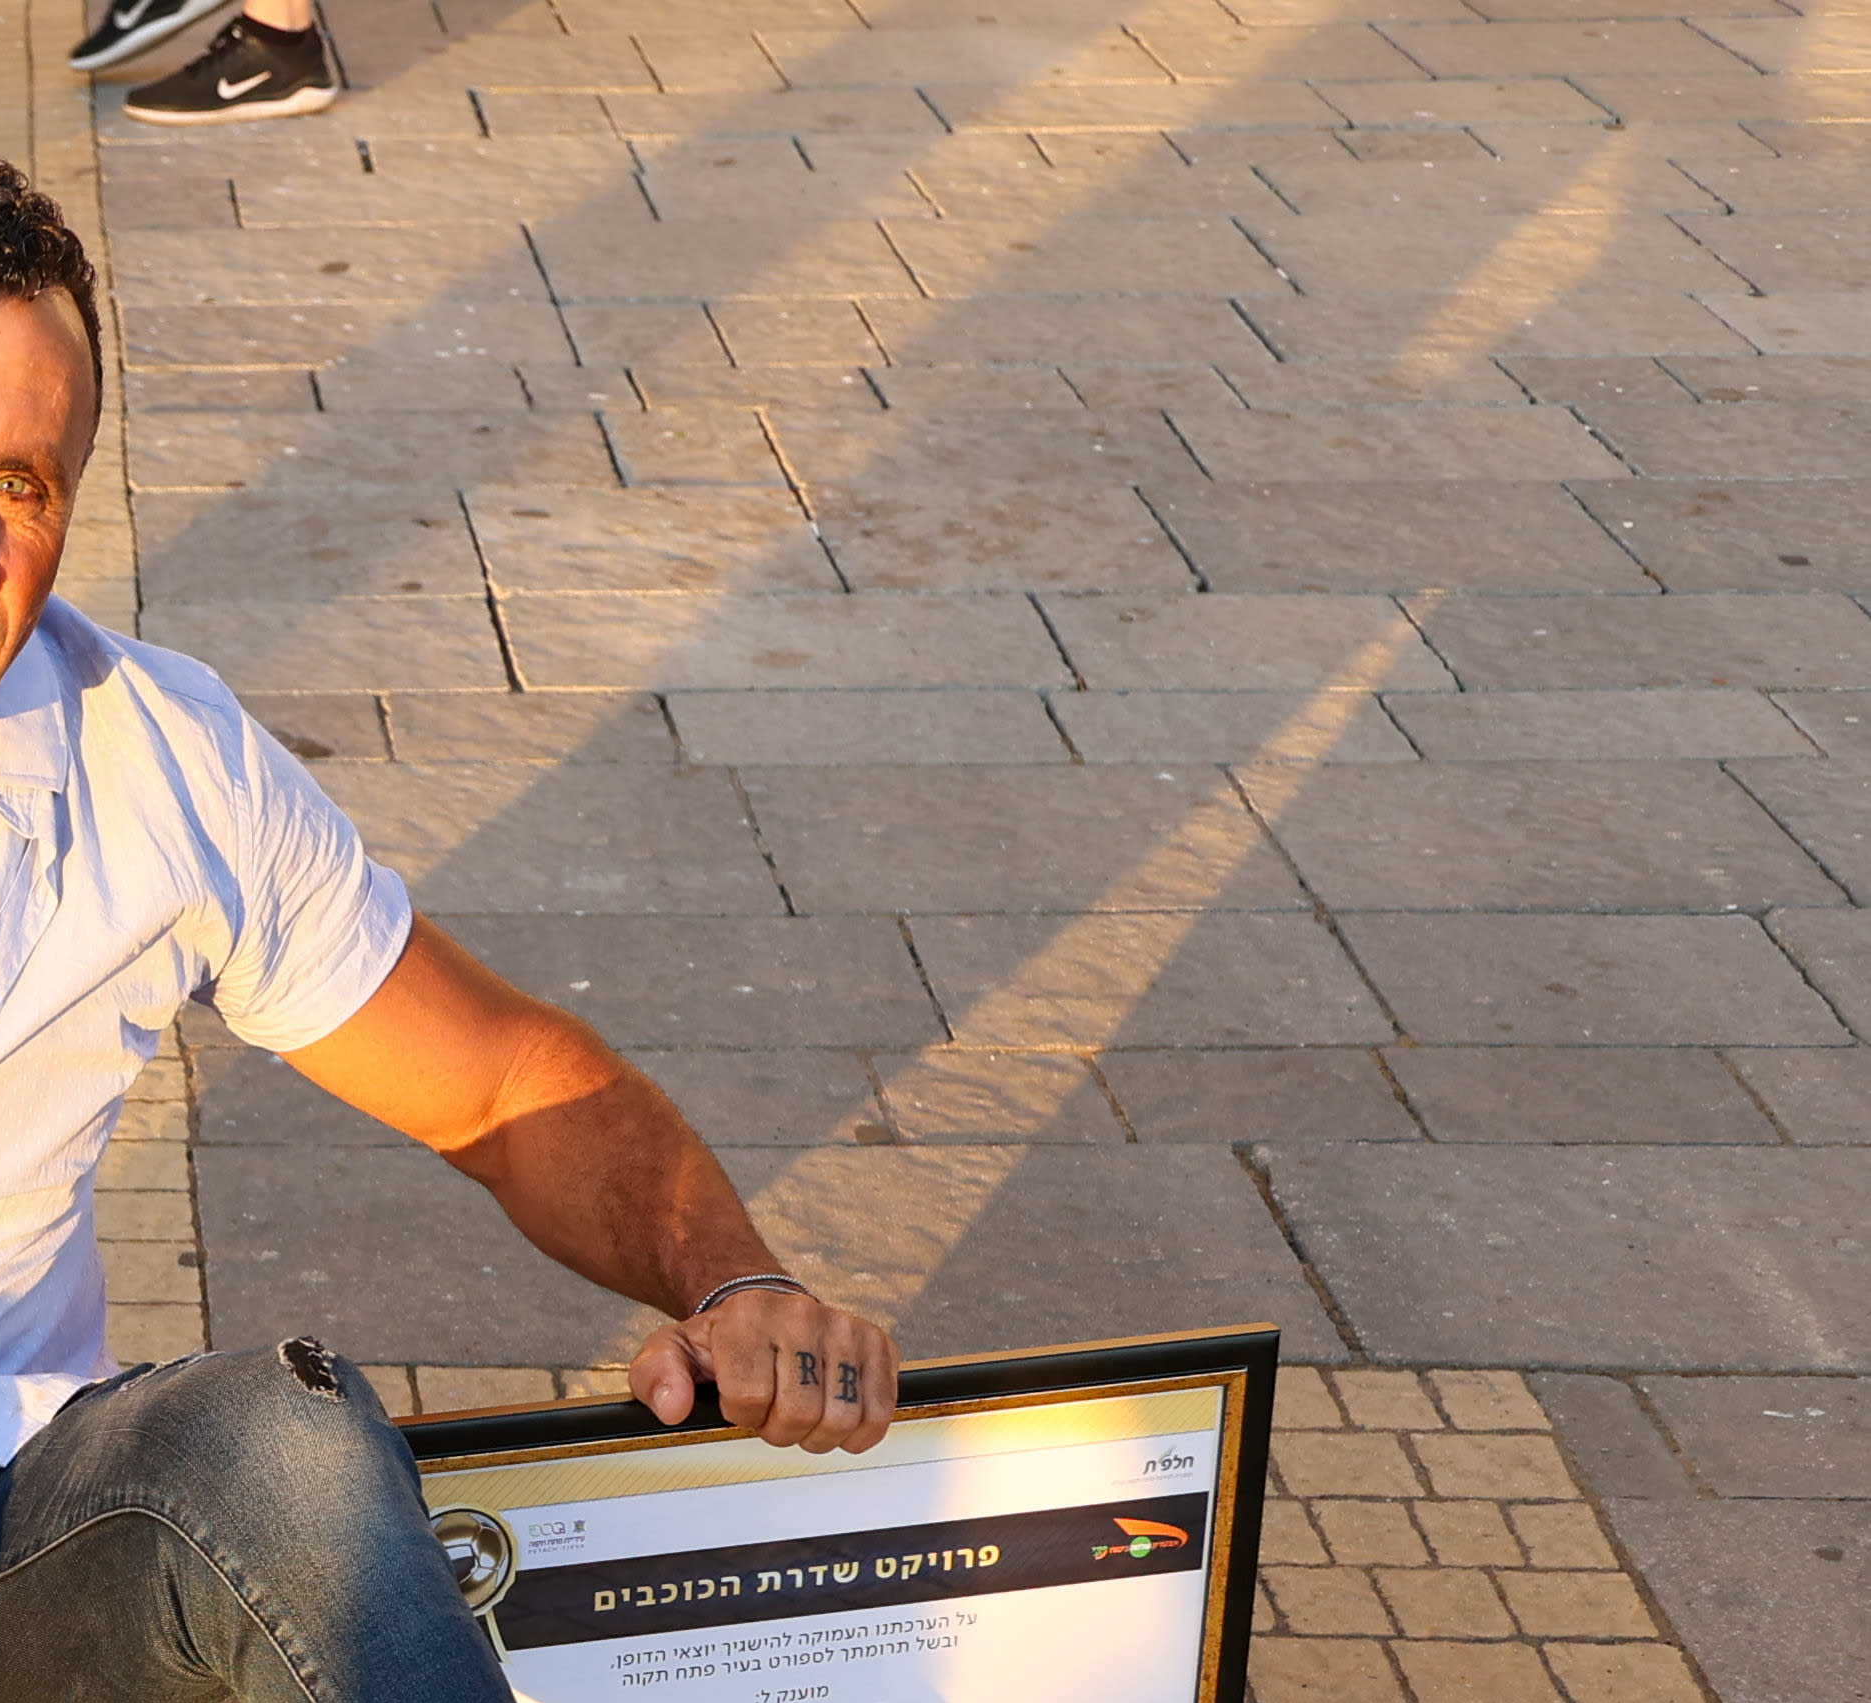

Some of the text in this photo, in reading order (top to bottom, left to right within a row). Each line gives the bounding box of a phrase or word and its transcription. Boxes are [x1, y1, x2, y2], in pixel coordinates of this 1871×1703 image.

[593, 1543, 1001, 1612] פרויקט שדרת הכוכבים
[609, 1610, 978, 1670] על הערכתנו העמוקה להישגיך יוצאי הדופן,
[622, 1635, 959, 1687] ובשל תרומתך לספורט בעיר פתח תקוה
